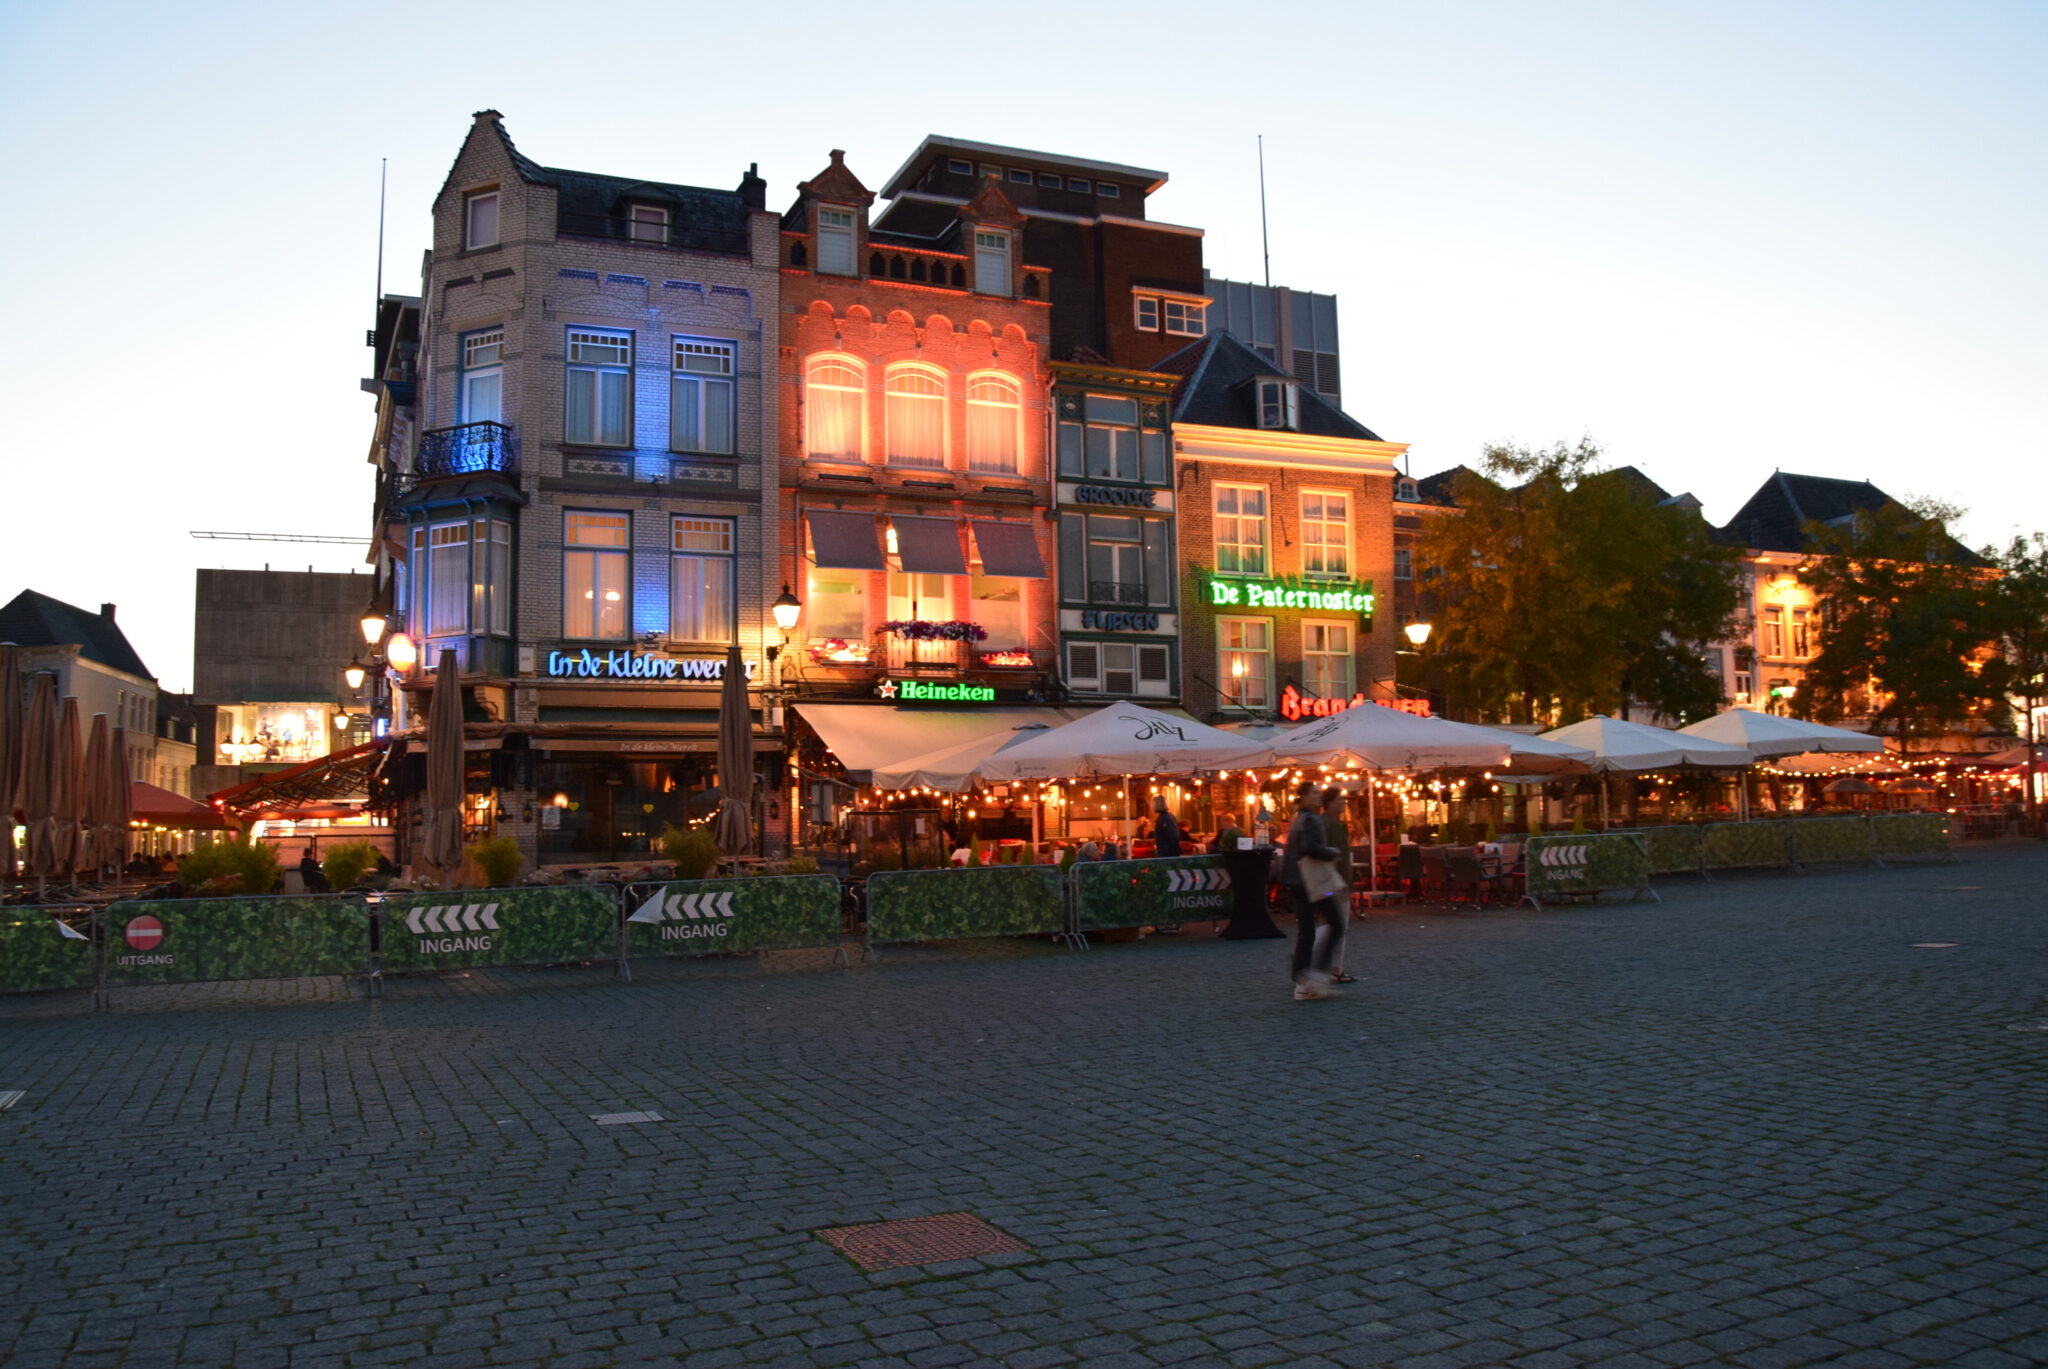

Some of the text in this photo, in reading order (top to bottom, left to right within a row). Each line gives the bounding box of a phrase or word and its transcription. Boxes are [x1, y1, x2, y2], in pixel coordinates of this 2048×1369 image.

[1076, 485, 1157, 508] BROODJE
[1210, 581, 1375, 612] De Paternoster
[1082, 609, 1159, 631] FLIPSEN
[577, 648, 602, 677] de
[608, 649, 677, 678] kleine
[682, 657, 757, 680] wert
[900, 681, 995, 701] Heineken
[1173, 895, 1224, 909] INGANG
[661, 922, 727, 940] INGANG
[420, 936, 492, 954] INGANG
[116, 954, 173, 965] UITGANG
